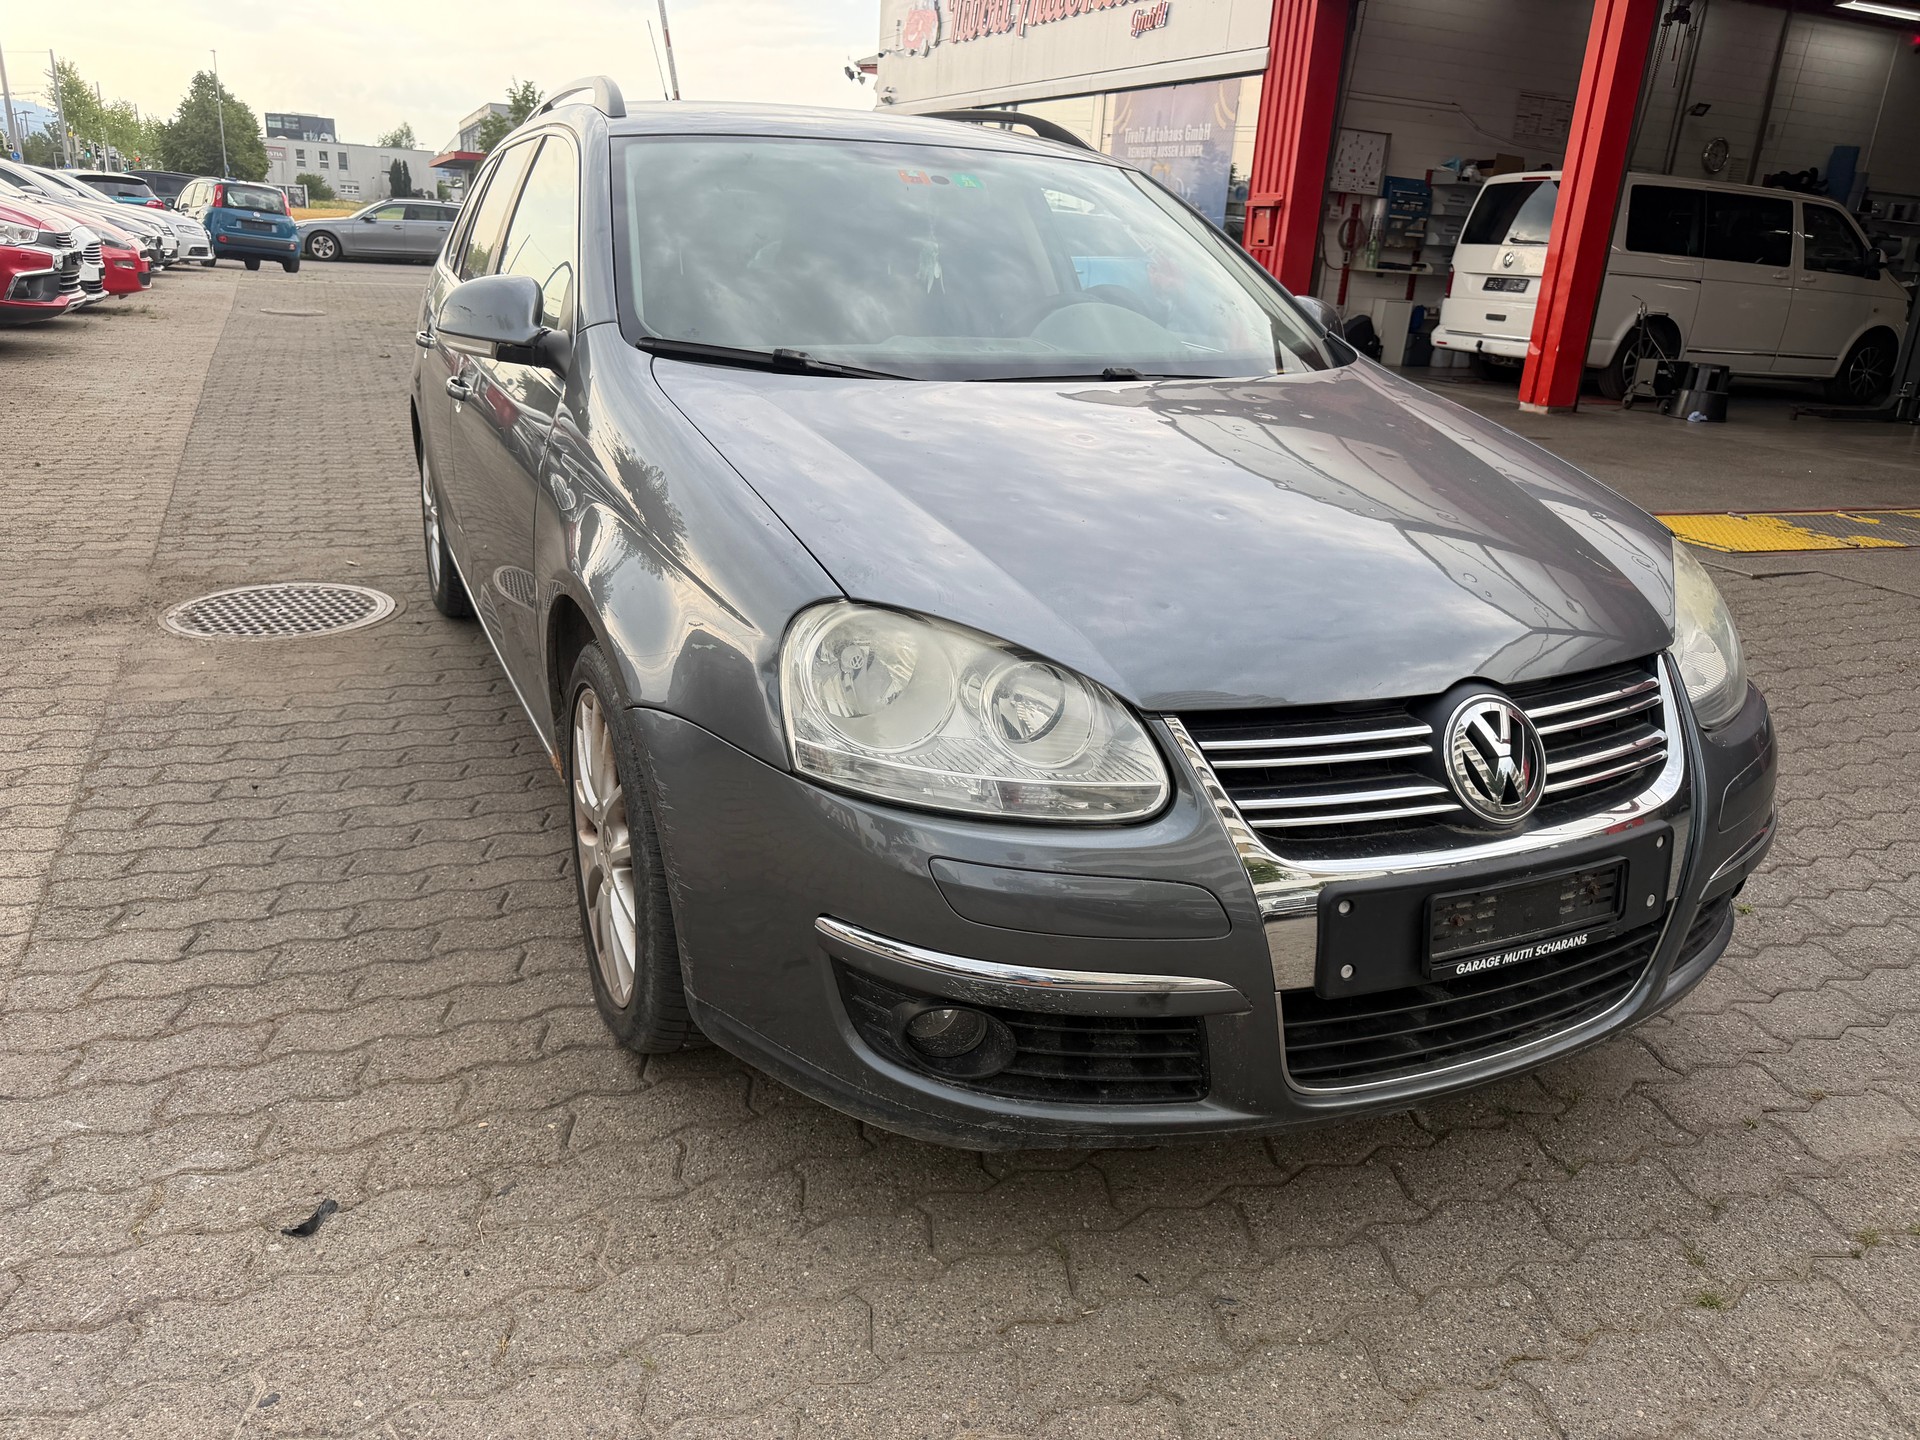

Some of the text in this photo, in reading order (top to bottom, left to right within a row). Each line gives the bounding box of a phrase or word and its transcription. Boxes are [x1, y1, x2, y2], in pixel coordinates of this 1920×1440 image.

[1130, 1, 1168, 39] GmbH
[1145, 125, 1184, 143] Autohaus
[1185, 123, 1211, 141] GmbH
[1449, 699, 1541, 815] VW
[1456, 934, 1588, 975] GARAGE MUTTI SCHARANS
